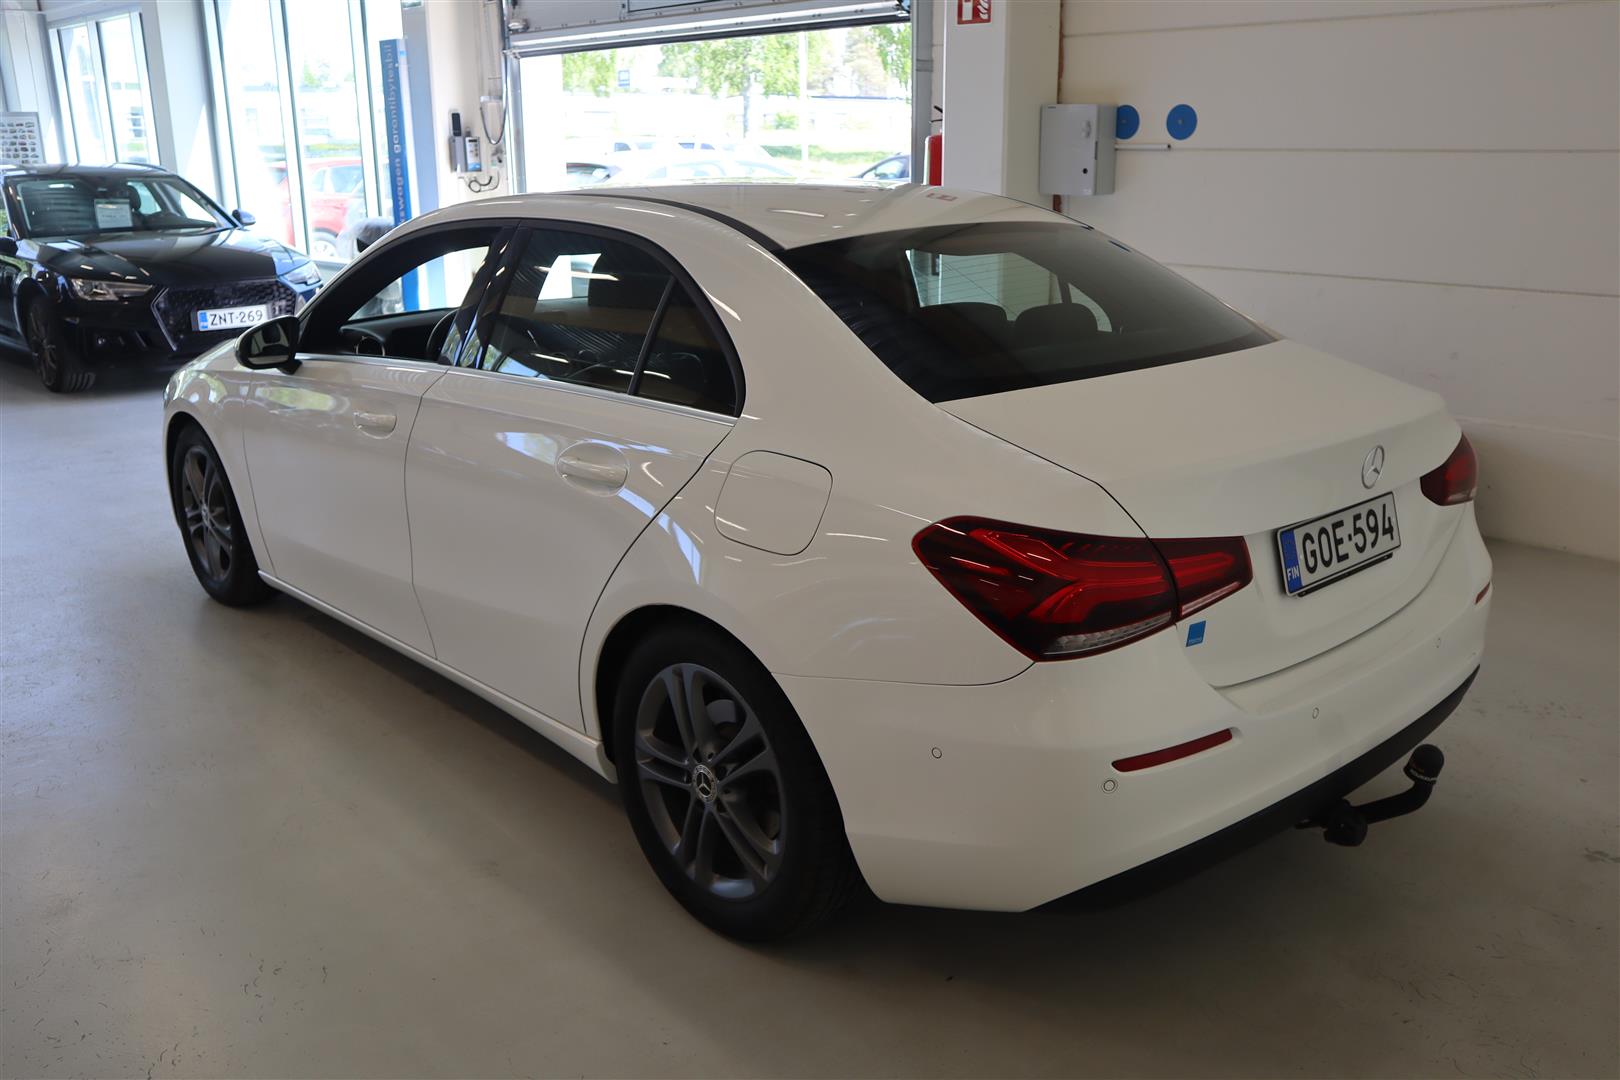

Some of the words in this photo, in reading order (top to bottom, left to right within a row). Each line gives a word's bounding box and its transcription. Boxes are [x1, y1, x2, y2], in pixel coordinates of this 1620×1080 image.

[210, 309, 263, 326] ZNT-269
[1302, 503, 1394, 574] GOE-594
[1286, 565, 1300, 581] FIN
